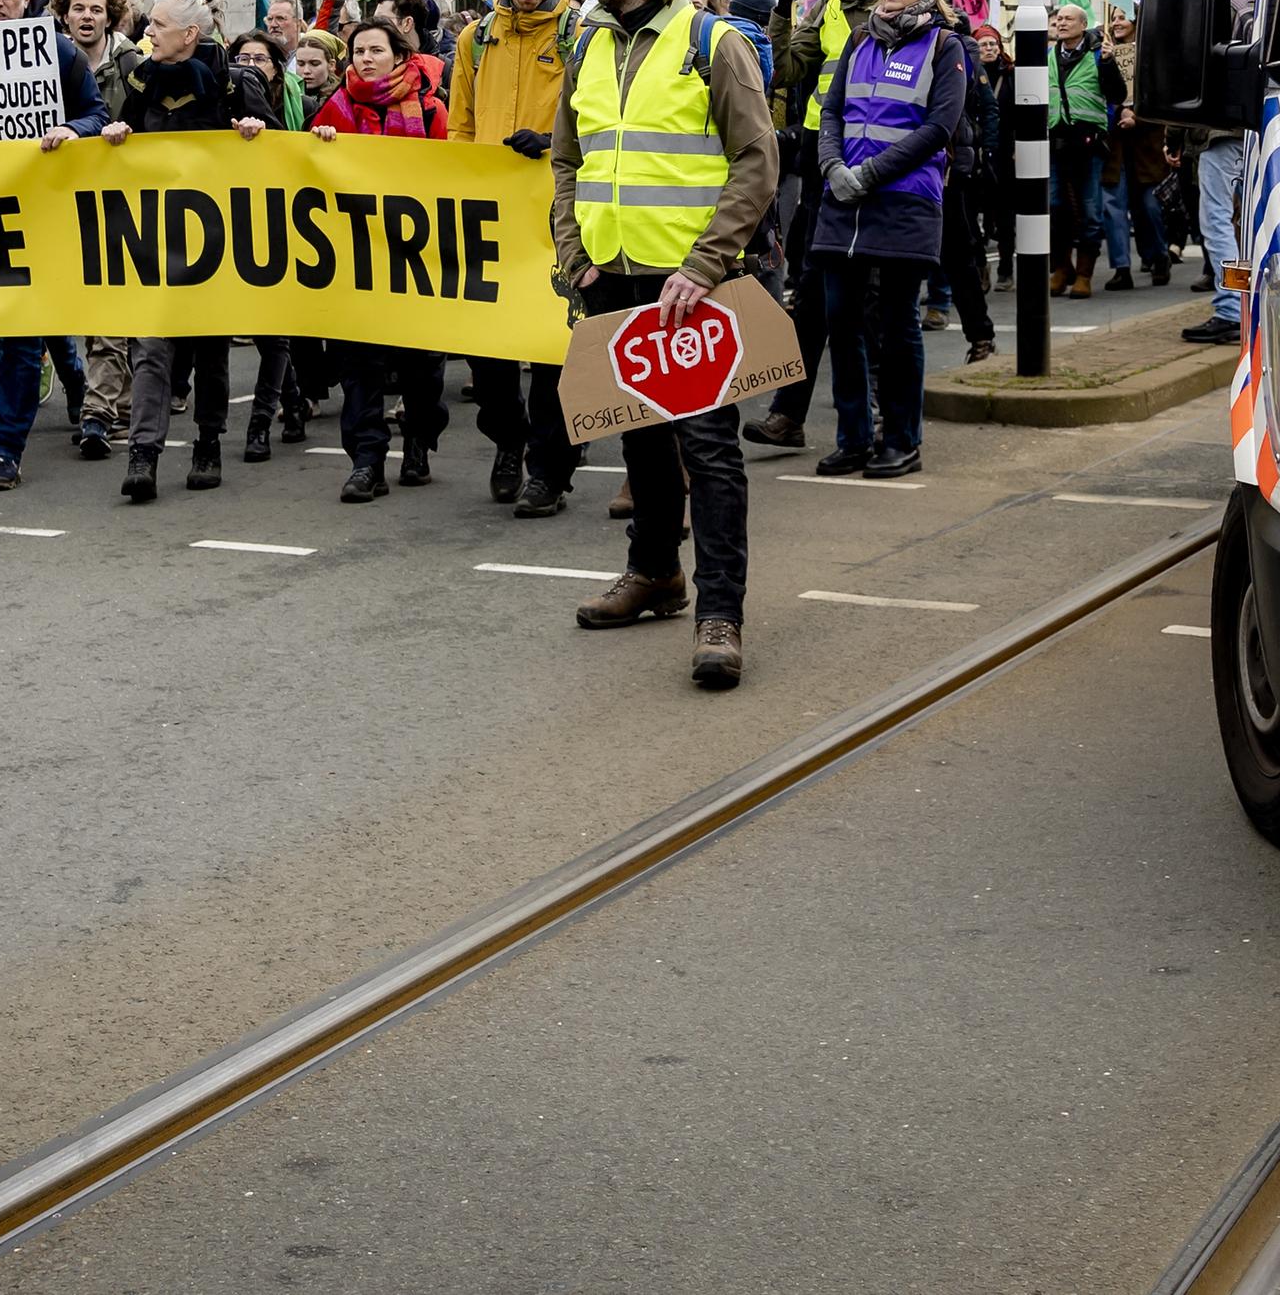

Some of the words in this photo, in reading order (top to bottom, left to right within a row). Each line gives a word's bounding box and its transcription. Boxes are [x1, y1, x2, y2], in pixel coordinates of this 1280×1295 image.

[2, 25, 52, 70] PER
[889, 61, 914, 73] POLITIE
[885, 70, 912, 82] LIAISON
[74, 186, 500, 303] INDUSTRIE
[624, 318, 724, 383] STOP
